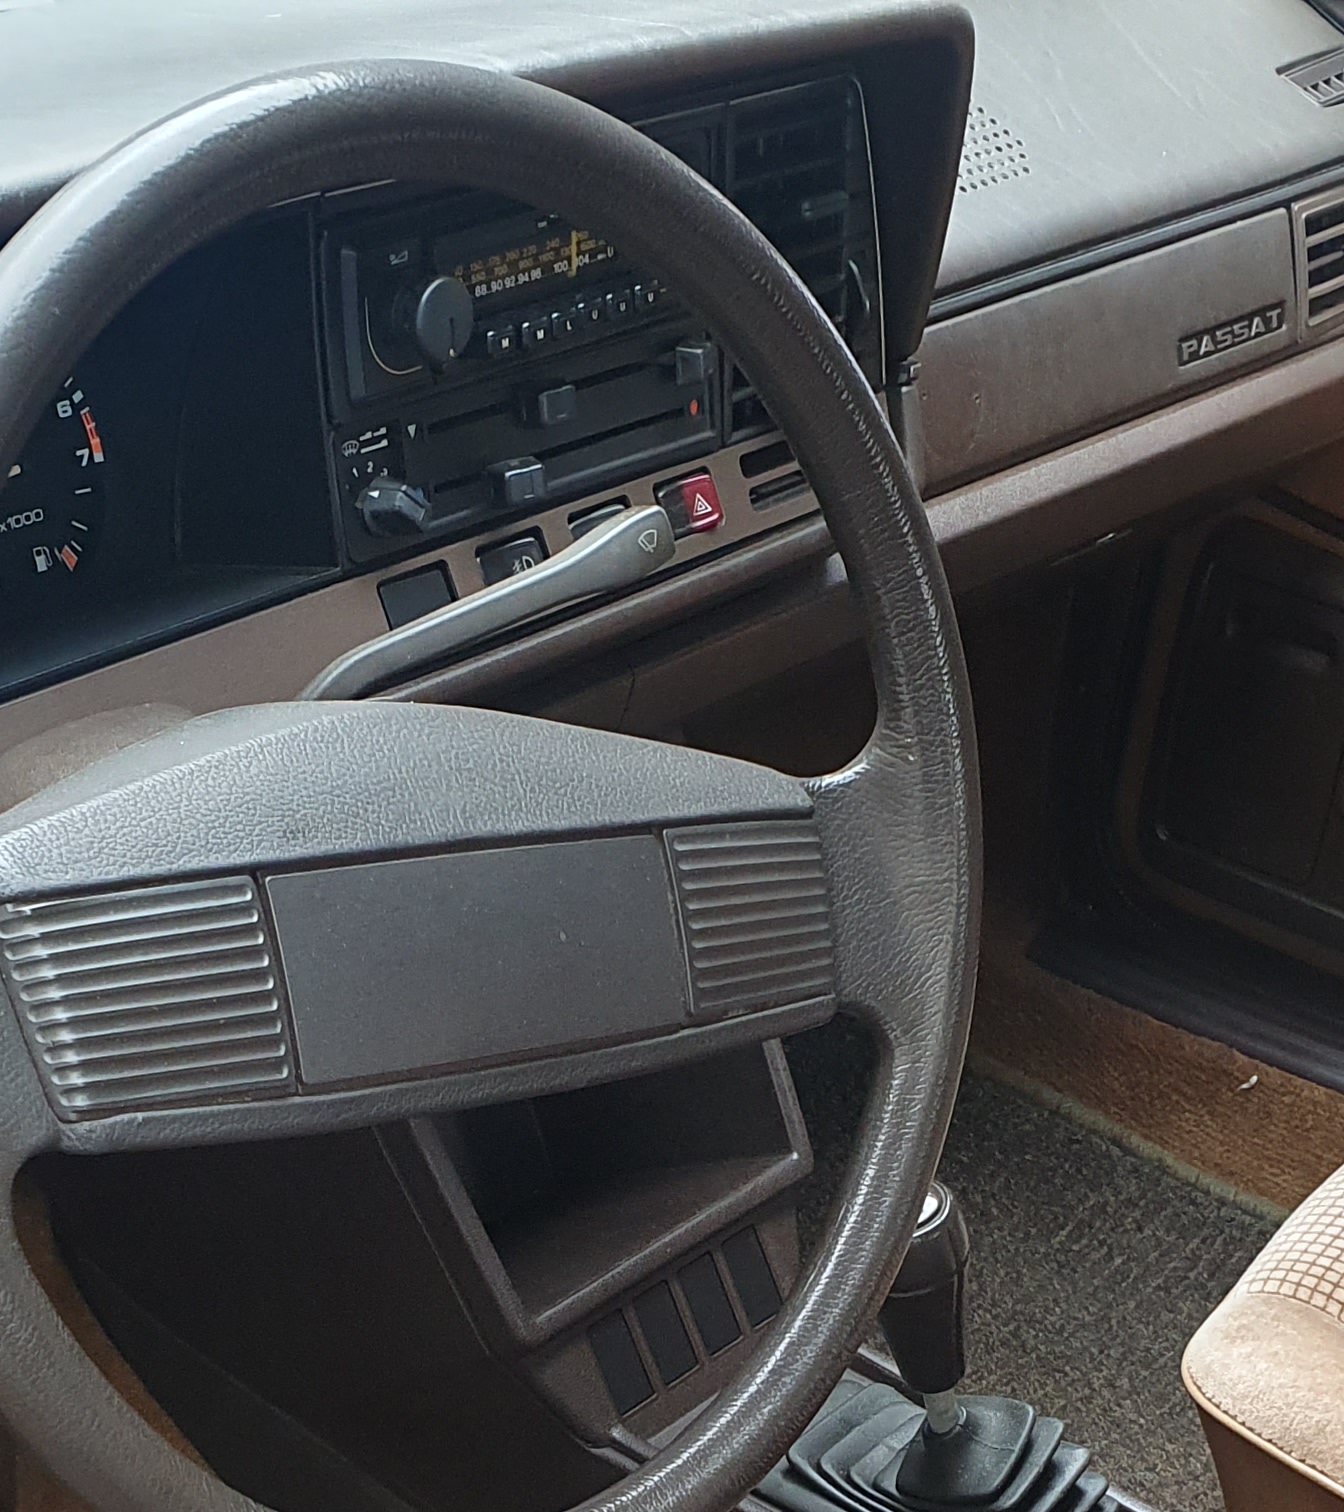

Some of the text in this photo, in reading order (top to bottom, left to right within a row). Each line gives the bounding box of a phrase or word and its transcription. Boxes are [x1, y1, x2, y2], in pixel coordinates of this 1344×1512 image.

[1180, 307, 1283, 361] PASSAT
[56, 400, 73, 418] 6
[75, 447, 90, 467] 7
[367, 461, 374, 473] 2
